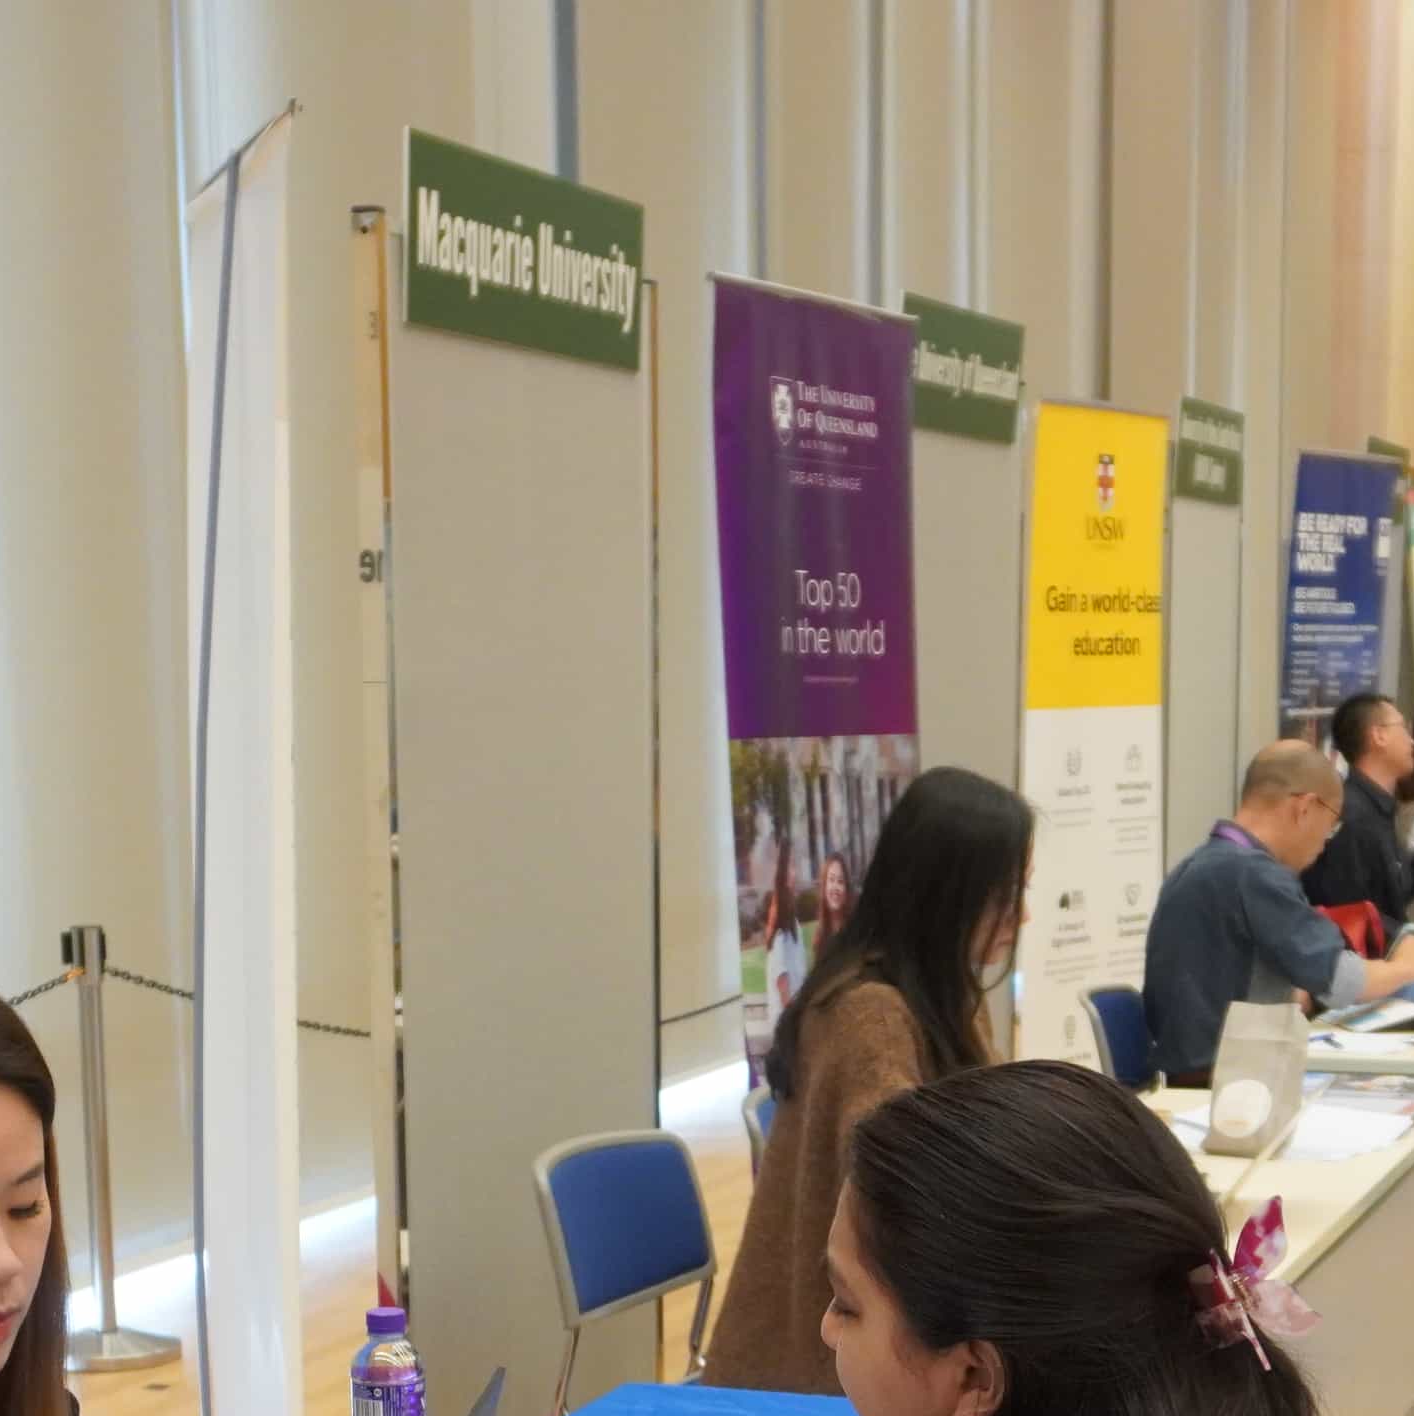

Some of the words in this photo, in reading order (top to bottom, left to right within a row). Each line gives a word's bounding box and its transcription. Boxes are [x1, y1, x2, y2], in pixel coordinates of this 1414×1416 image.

[418, 186, 534, 298] Macquarie
[538, 222, 636, 333] University
[795, 380, 819, 403] THE
[815, 410, 878, 438] QUEENSLAND
[795, 569, 834, 613] Top
[837, 571, 861, 608] 50
[1045, 584, 1078, 613] Gain
[1080, 592, 1088, 613] a
[780, 616, 794, 653] in
[797, 617, 831, 655] the
[835, 618, 885, 656] world
[1073, 631, 1141, 657] education
